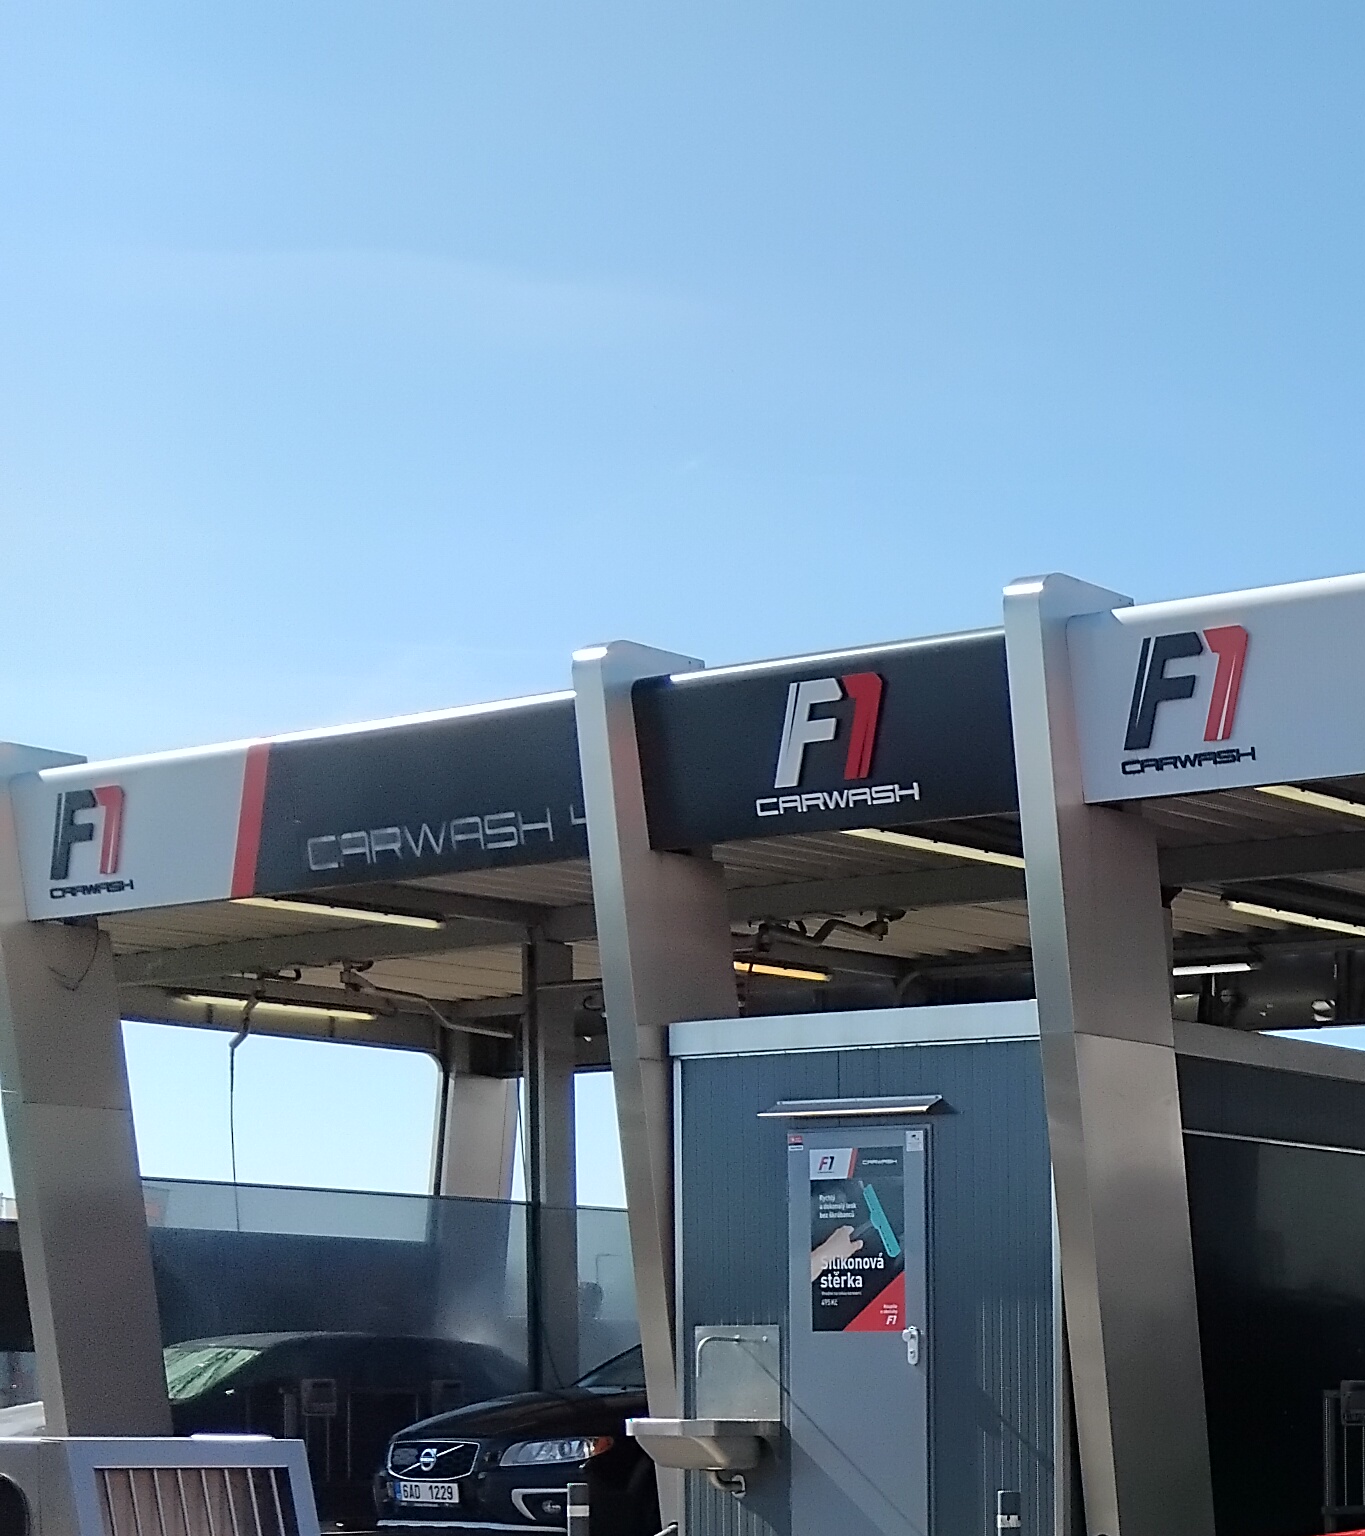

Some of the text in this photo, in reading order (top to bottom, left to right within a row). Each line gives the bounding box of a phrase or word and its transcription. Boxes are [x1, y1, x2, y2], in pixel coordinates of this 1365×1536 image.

[1124, 625, 1248, 750] F1
[774, 672, 883, 788] F1
[1121, 747, 1256, 775] CARWASH
[756, 782, 920, 816] CARWASH
[50, 785, 125, 880] F1
[307, 807, 553, 872] CARWASH
[49, 879, 134, 899] CARWASH
[819, 1156, 834, 1170] F1
[821, 1252, 884, 1269] Silikonová
[820, 1271, 863, 1288] stěrka
[402, 1484, 453, 1500] 6AD 1229
